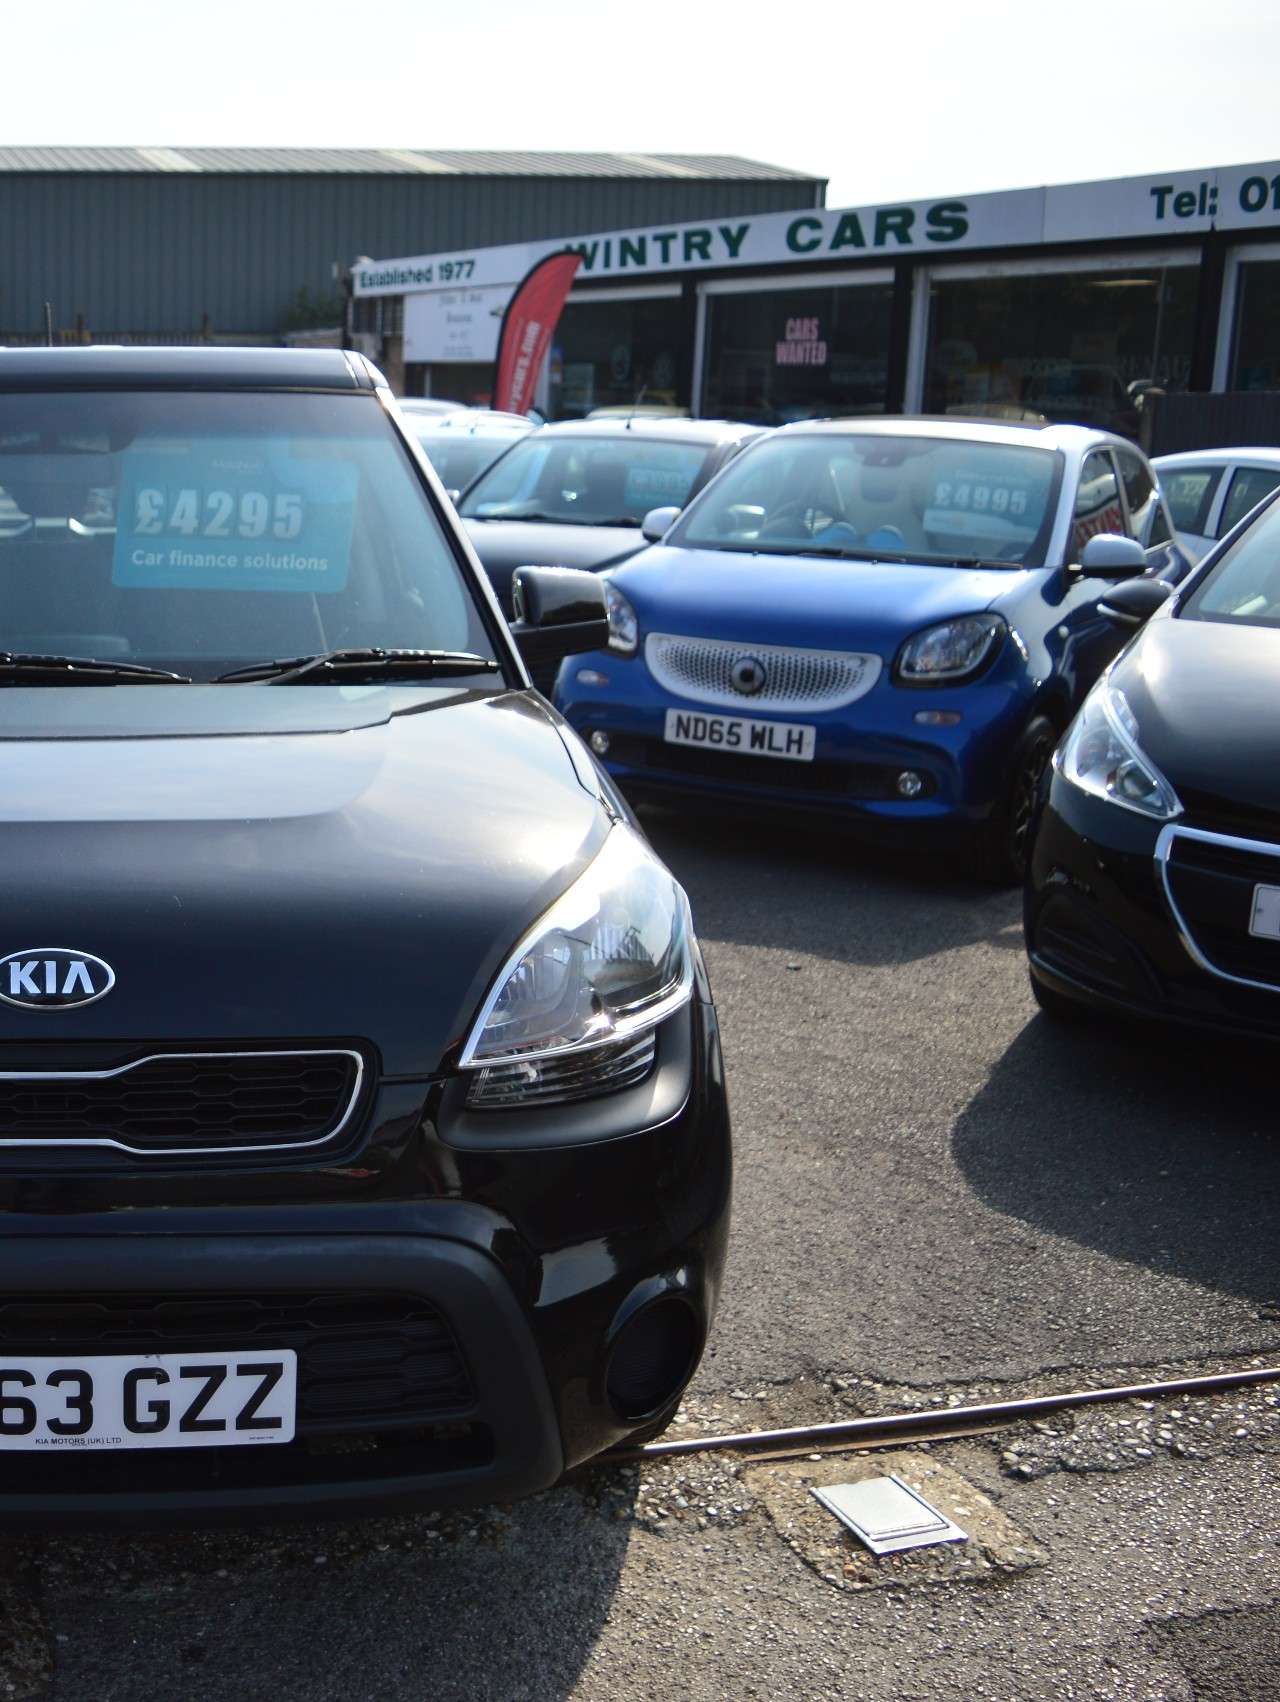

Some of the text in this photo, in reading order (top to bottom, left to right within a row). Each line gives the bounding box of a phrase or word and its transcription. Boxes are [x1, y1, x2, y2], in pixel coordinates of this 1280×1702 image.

[1150, 181, 1219, 219] Tel:
[565, 200, 969, 270] WINTRY CARS
[359, 259, 476, 289] Established 1977
[785, 317, 819, 340] CARS
[776, 340, 827, 365] WANTED
[134, 488, 303, 539] £4295
[131, 549, 329, 572] Car finance solutions
[675, 714, 805, 755] ND65 WLH
[8, 960, 95, 995] KIA
[123, 1361, 285, 1435] GZZ
[106, 1436, 122, 1444] LTD
